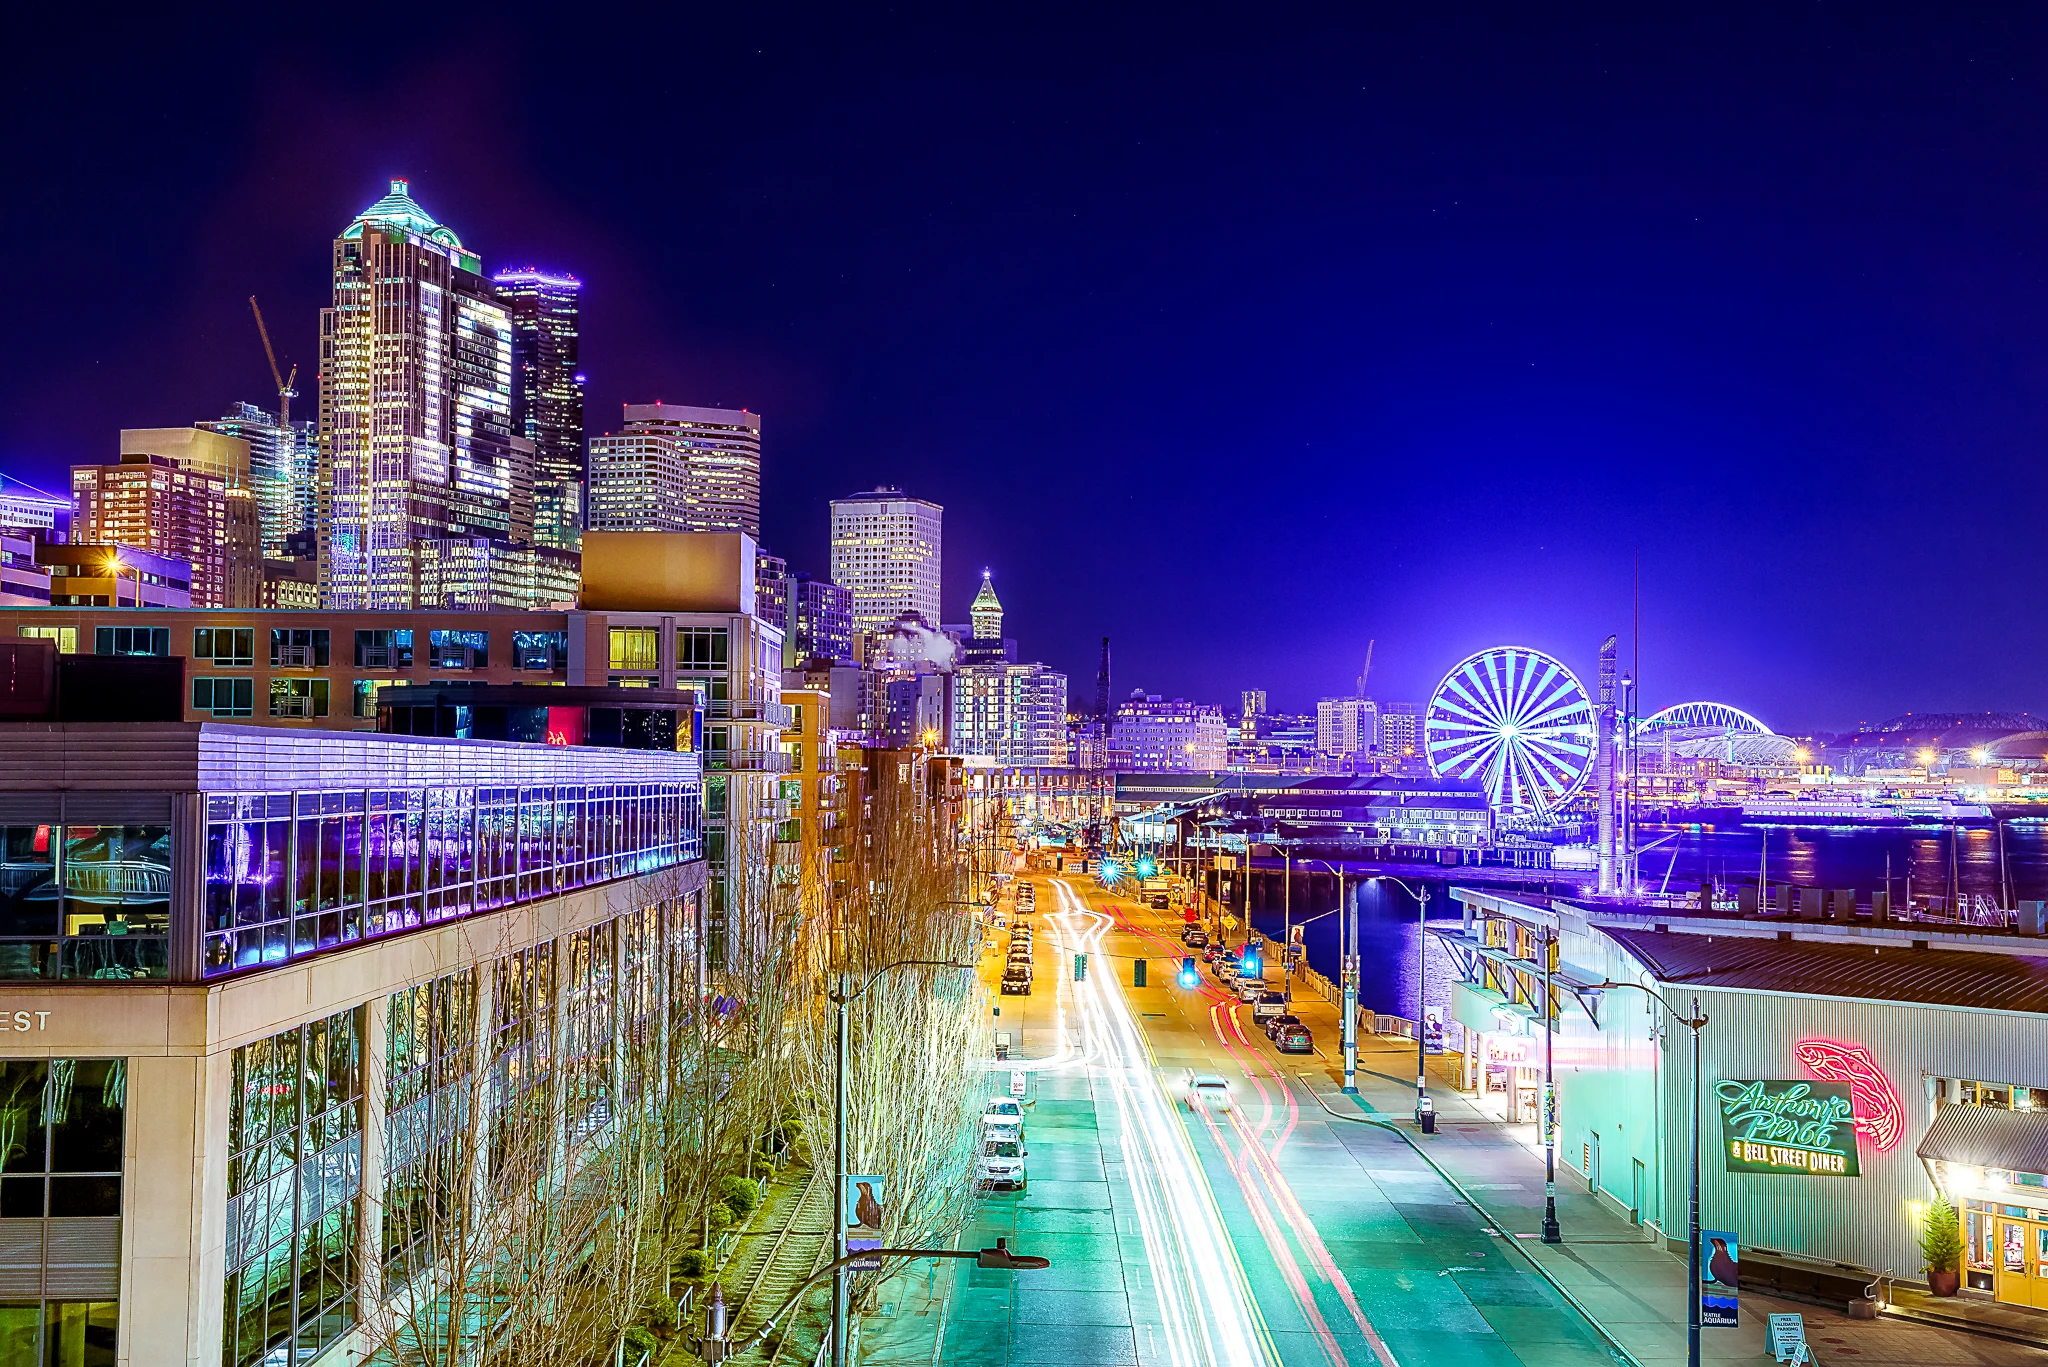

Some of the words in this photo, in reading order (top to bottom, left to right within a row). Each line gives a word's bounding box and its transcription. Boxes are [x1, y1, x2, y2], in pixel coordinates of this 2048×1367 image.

[1713, 1080, 1855, 1126] Anthony's
[1730, 1111, 1799, 1144] Pier
[1798, 1121, 1838, 1148] 66
[1732, 1141, 1742, 1158] &
[1744, 1143, 1769, 1163] BELL
[1770, 1149, 1808, 1168] STREET
[1809, 1152, 1845, 1173] DINER
[1703, 1316, 1737, 1325] AQUARIUM
